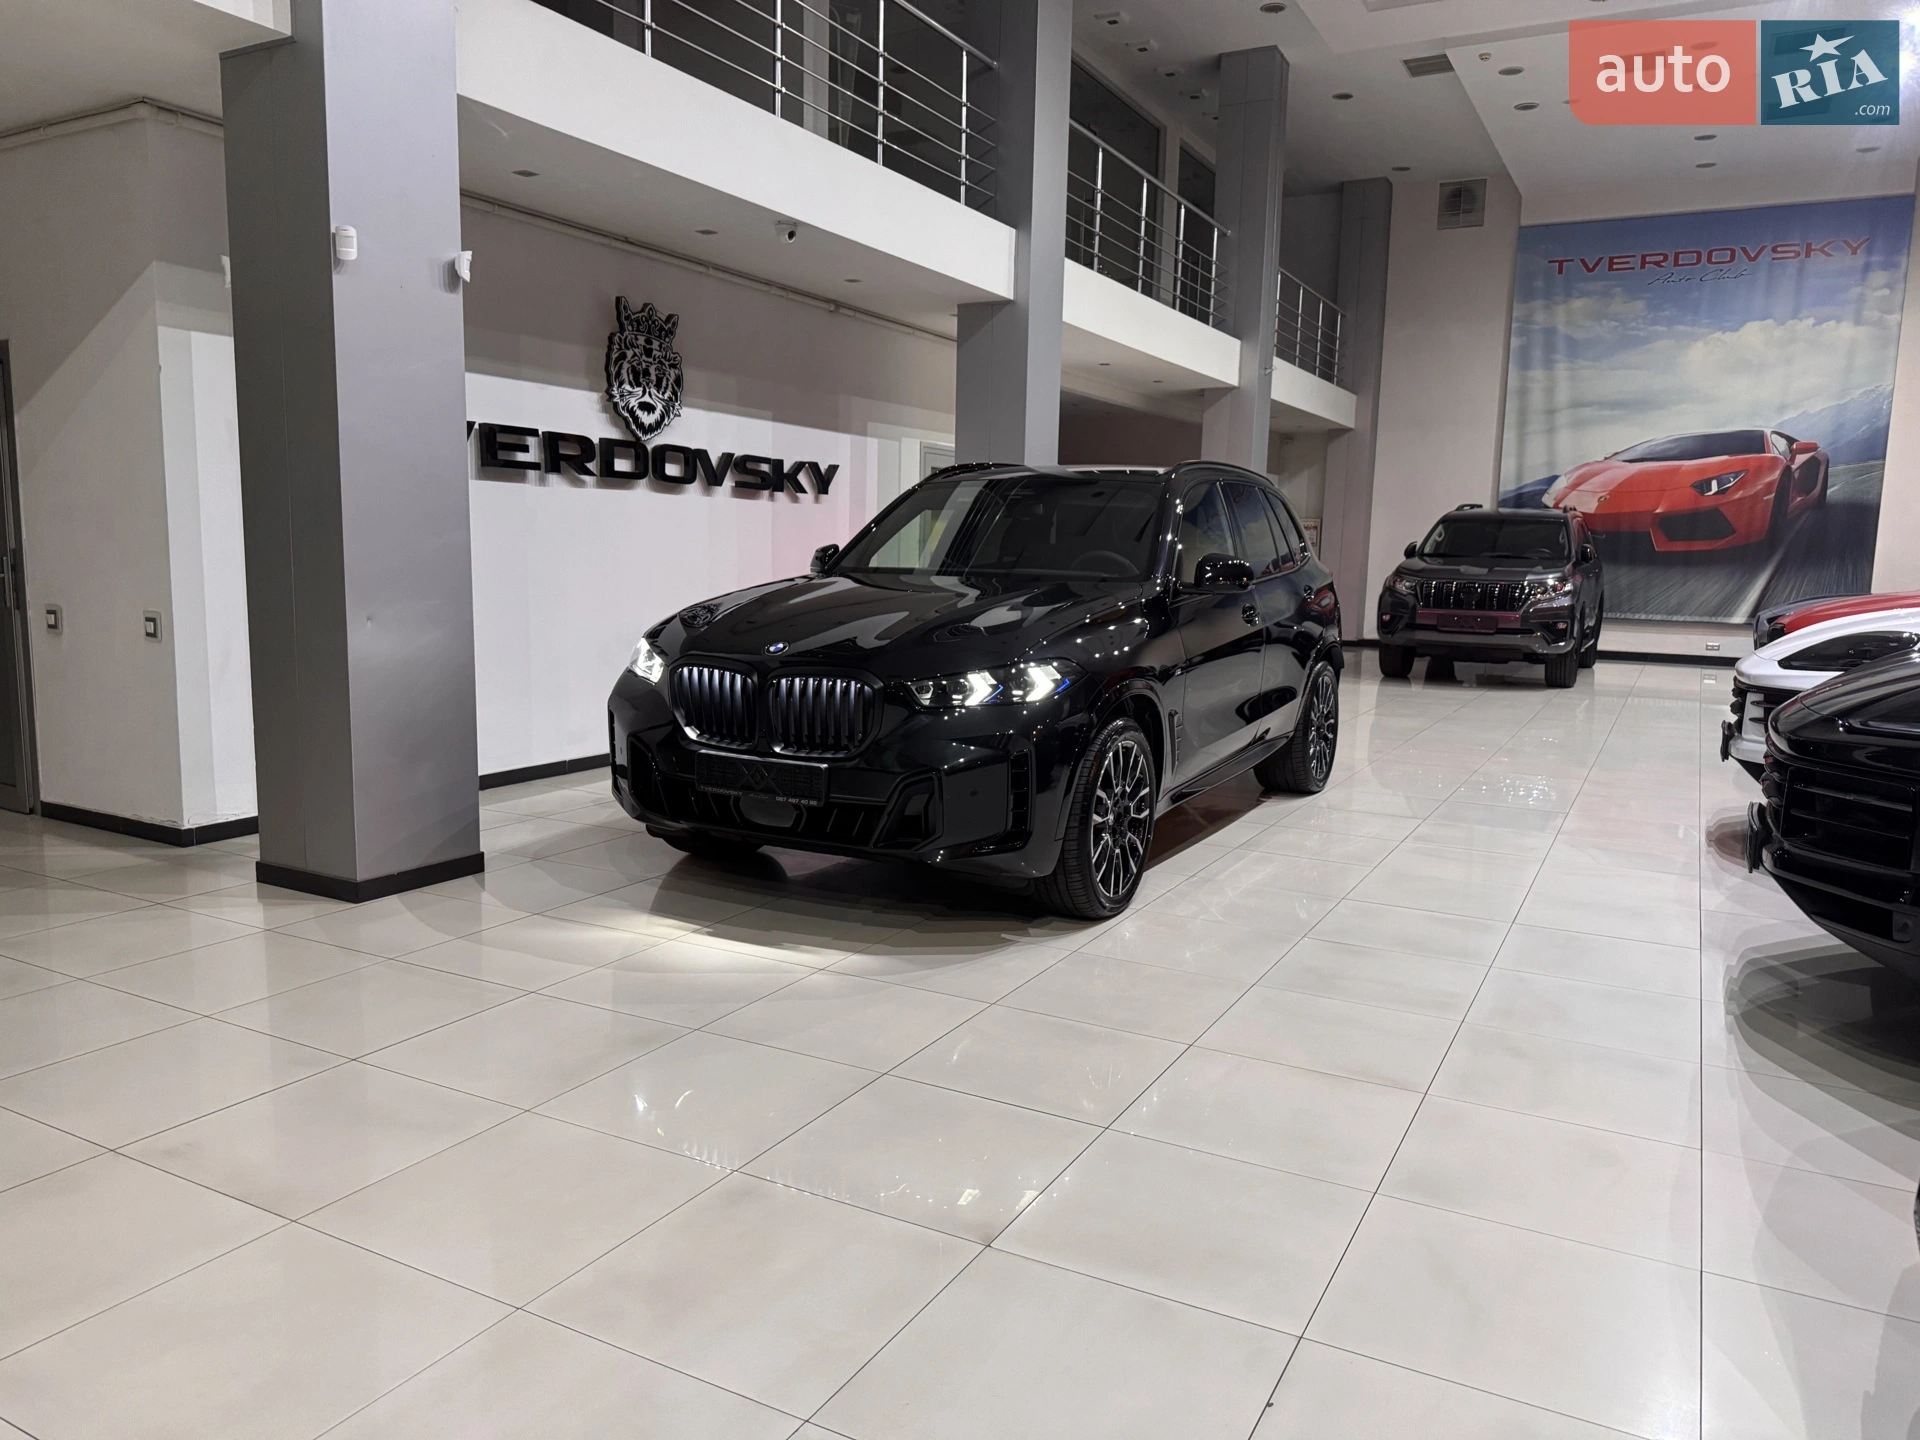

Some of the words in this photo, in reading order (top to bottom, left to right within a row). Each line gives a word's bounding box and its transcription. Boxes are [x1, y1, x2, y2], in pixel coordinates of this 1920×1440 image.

[1547, 237, 1872, 276] TVERDOVSKY
[1647, 272, 1696, 285] Auto
[1699, 268, 1752, 282] Club
